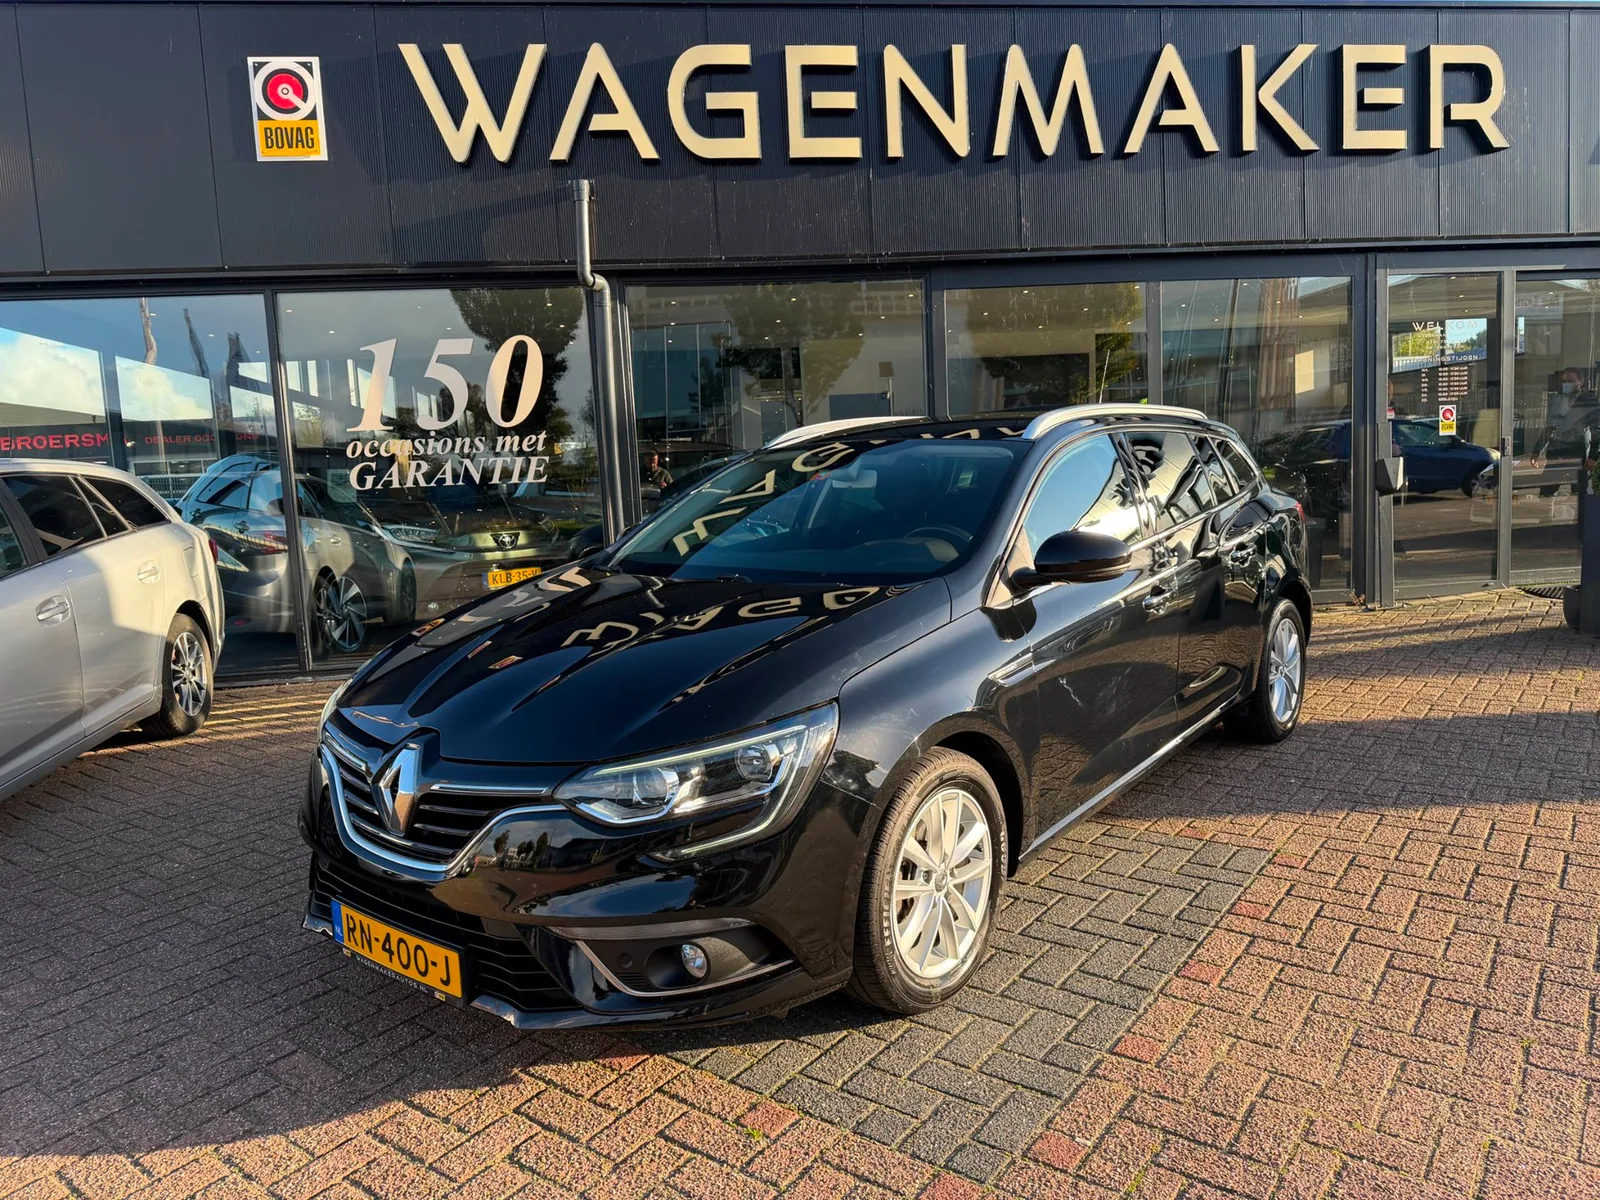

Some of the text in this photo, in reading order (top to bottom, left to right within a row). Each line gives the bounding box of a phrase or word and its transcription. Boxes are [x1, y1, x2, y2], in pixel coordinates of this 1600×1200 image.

[398, 42, 1511, 164] WAGENMAKER
[264, 126, 315, 149] BOVAG
[346, 334, 544, 432] 150
[0, 432, 128, 452] BROERSM
[145, 434, 191, 445] DEALER
[346, 430, 548, 459] occasions met
[350, 456, 550, 491] GARANTIE
[345, 912, 451, 987] RN-400-J
